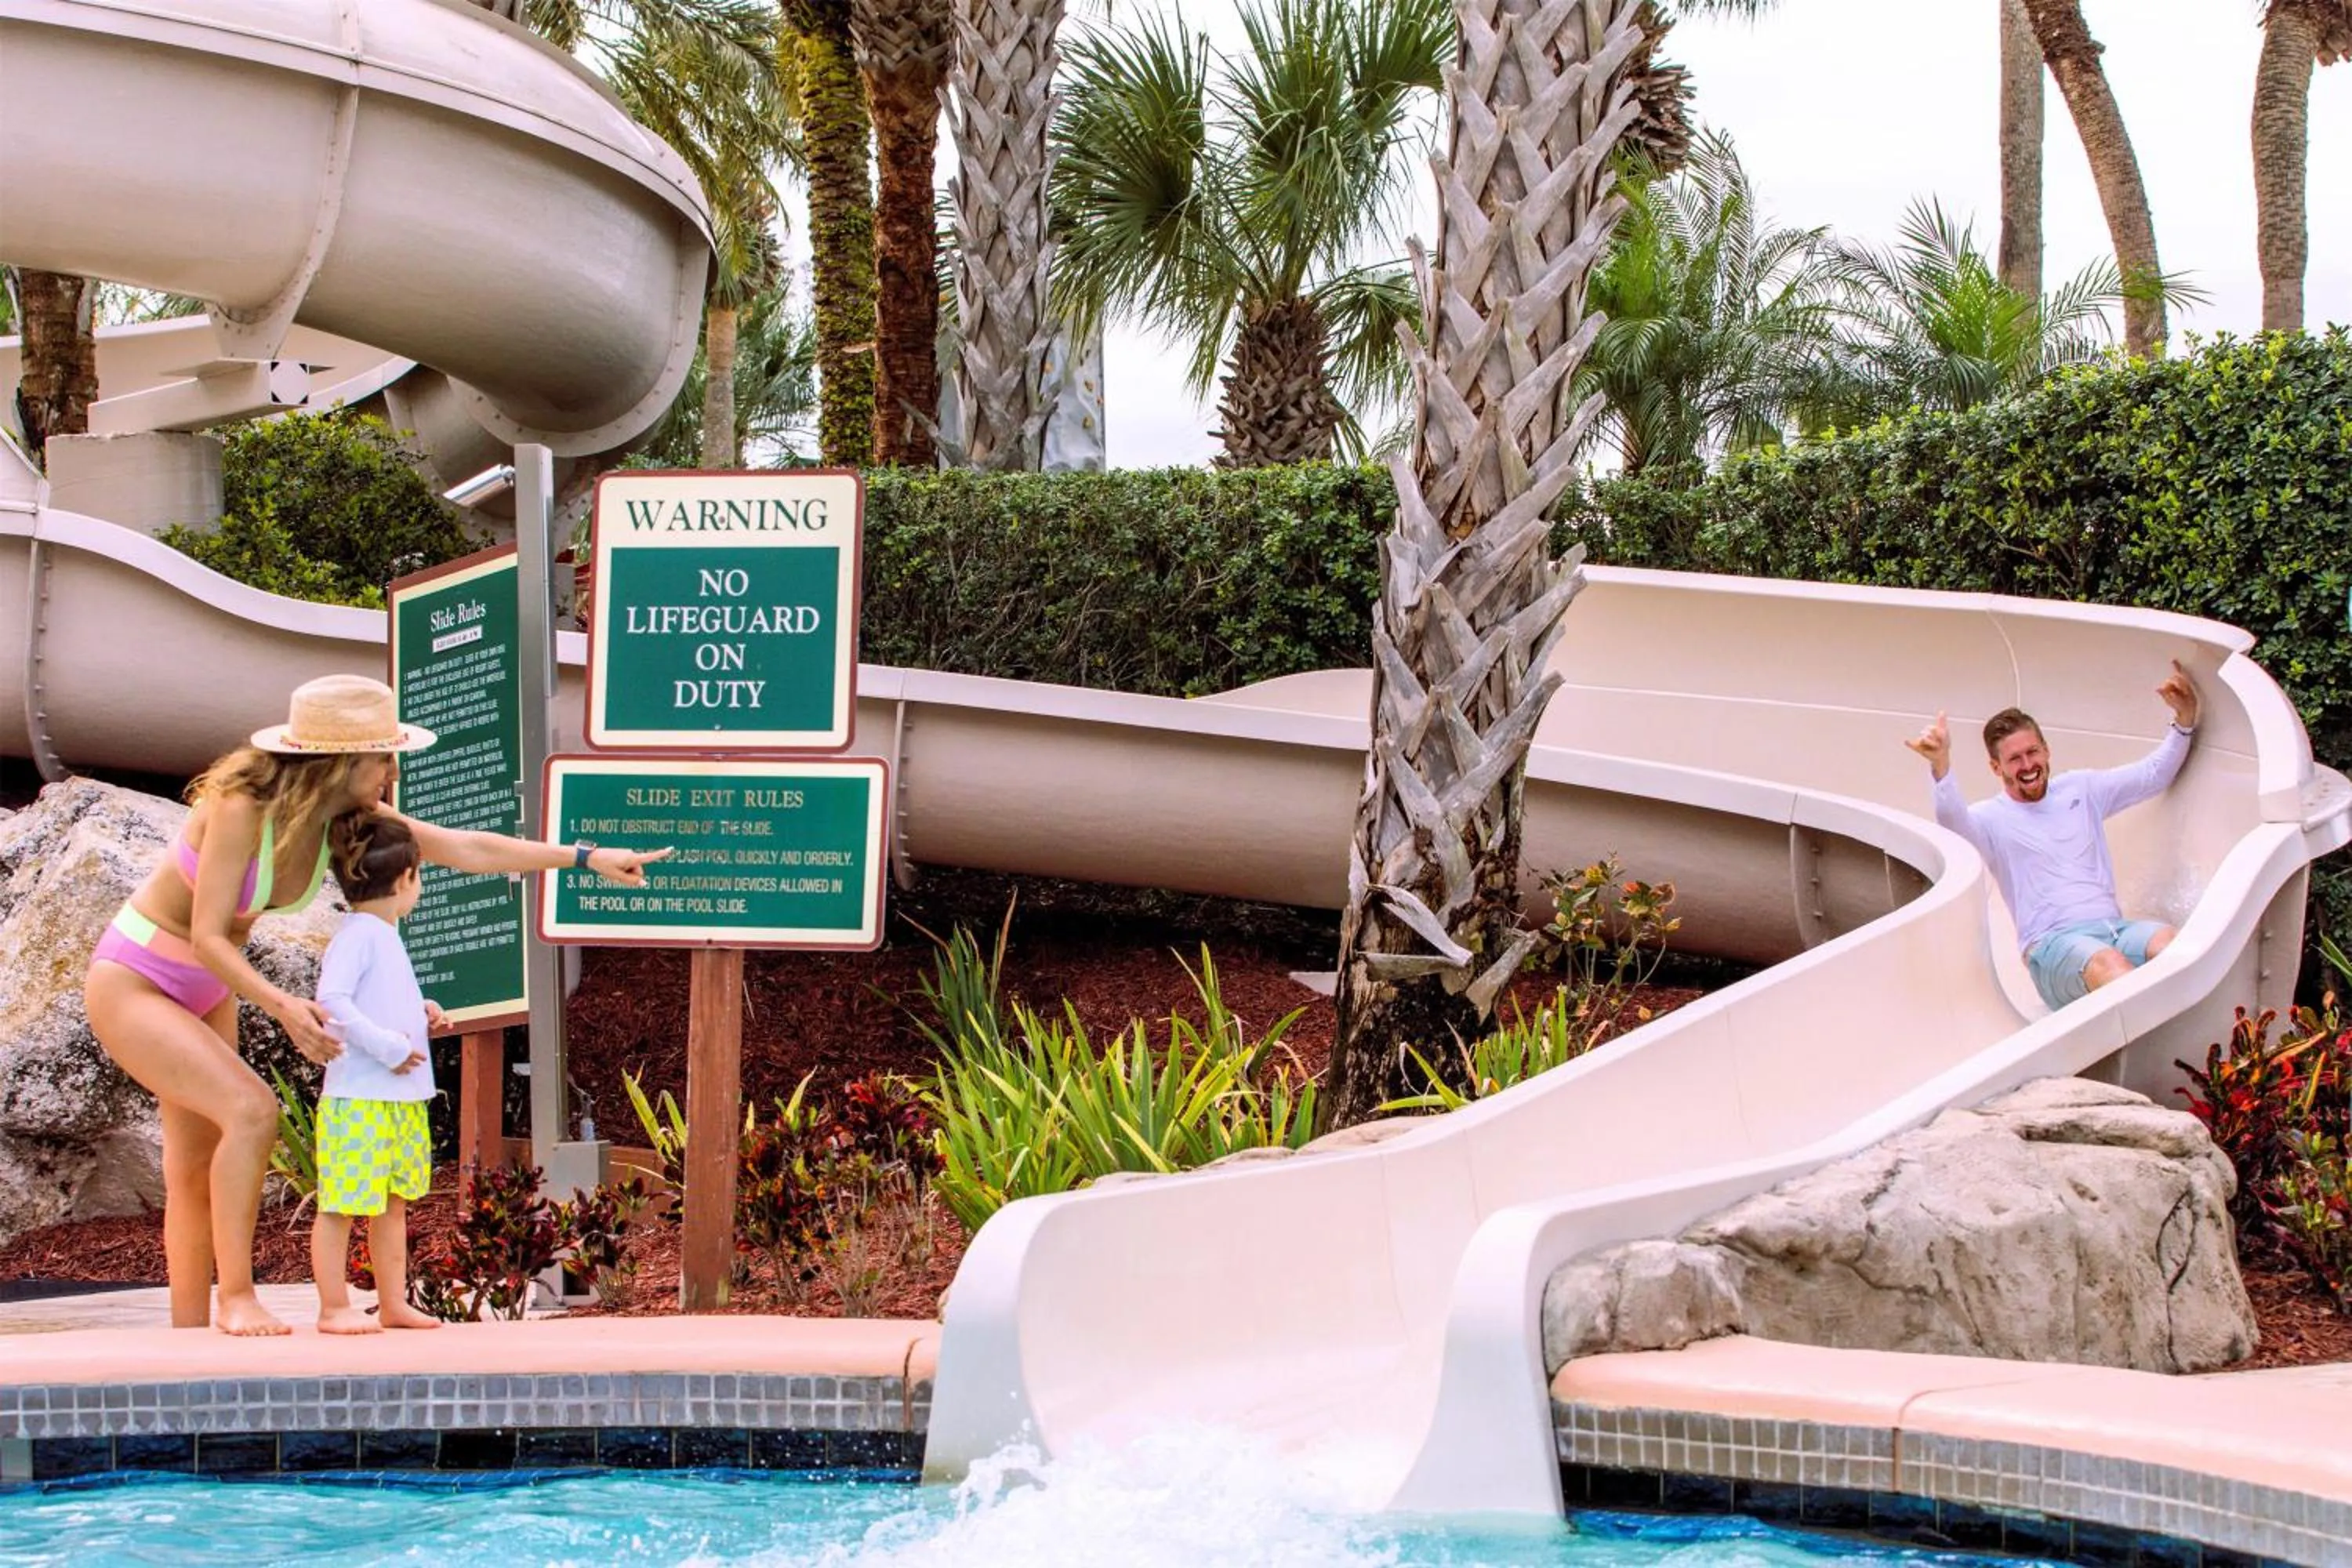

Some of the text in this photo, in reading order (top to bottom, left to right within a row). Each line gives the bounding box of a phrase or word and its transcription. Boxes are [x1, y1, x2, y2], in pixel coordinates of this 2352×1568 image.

[626, 499, 828, 532] WARNING
[699, 569, 750, 597] NO
[430, 598, 487, 633] Slide Rules
[626, 606, 821, 633] LIFEGUARD
[695, 643, 746, 670] ON
[673, 680, 766, 708] DUTY
[626, 788, 804, 808] SLIDE EXIT RULES
[570, 818, 579, 833] 1.
[581, 818, 597, 833] DO
[598, 819, 619, 833] NOT
[622, 820, 674, 833] OBSTRUCT
[677, 820, 699, 834] END
[702, 821, 713, 834] OF
[720, 821, 739, 836] THE
[735, 850, 779, 865] QUICKLY
[780, 851, 801, 866] AND
[804, 851, 854, 866] ORDERLY.
[567, 874, 576, 888] 3.
[579, 875, 593, 888] NO
[653, 876, 667, 890] OR
[670, 876, 731, 891] FLOATATION
[734, 877, 777, 892] DEVICES
[779, 877, 829, 893] ALLOWED
[831, 879, 843, 893] IN
[579, 896, 598, 911] THE
[601, 896, 627, 911] POOL
[630, 897, 645, 912] OR
[647, 897, 662, 912] ON
[664, 898, 684, 912] THE
[687, 898, 713, 913] POOL
